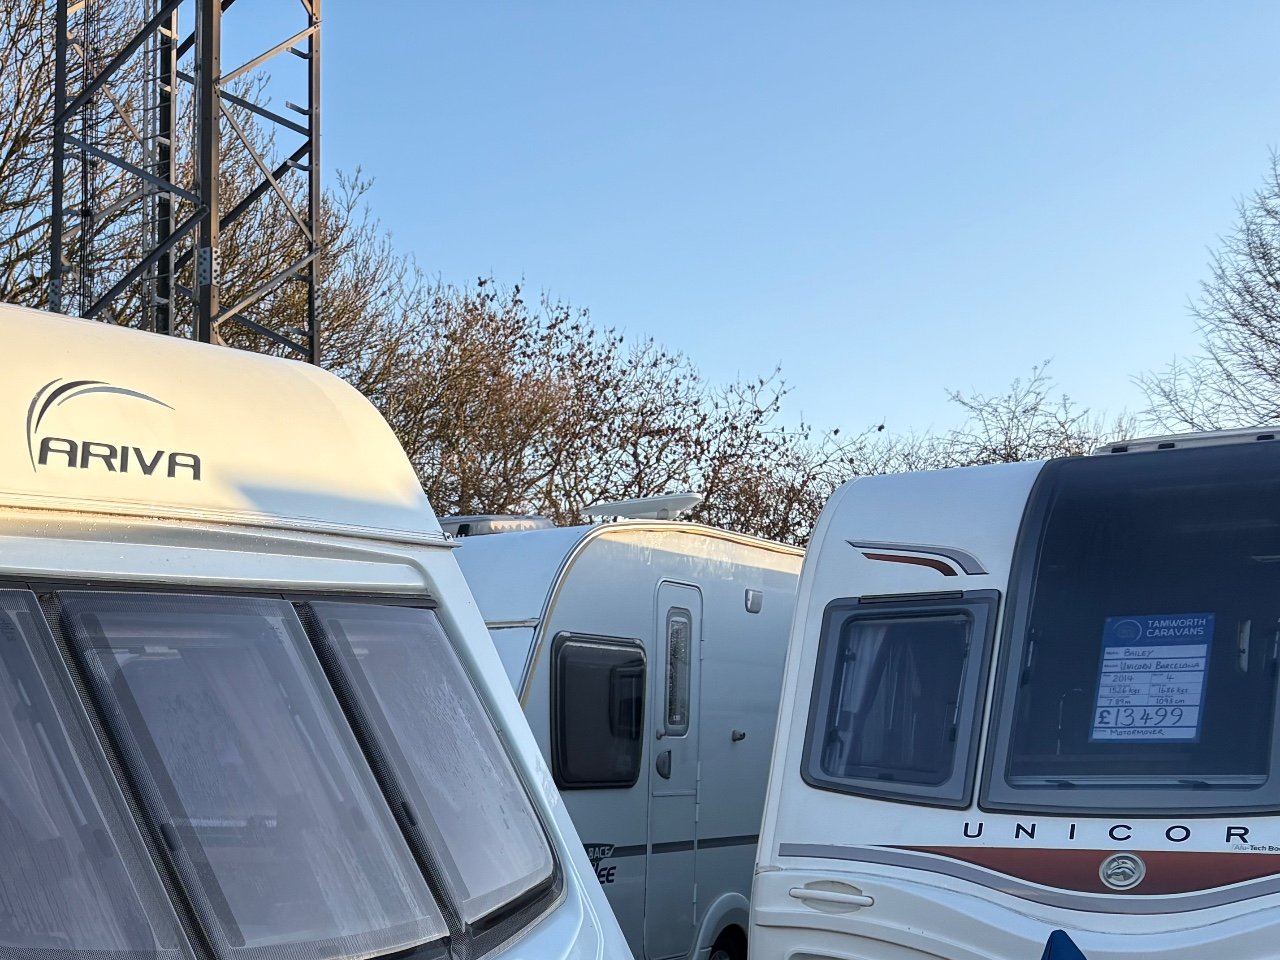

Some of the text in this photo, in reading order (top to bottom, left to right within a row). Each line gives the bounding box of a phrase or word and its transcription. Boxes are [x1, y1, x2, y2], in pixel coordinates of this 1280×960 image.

[38, 436, 201, 481] ARIVA
[1147, 618, 1206, 627] TAMWORTH
[1146, 627, 1204, 637] CARAVANS
[1123, 648, 1154, 658] BAILEY
[963, 822, 1250, 844] UNICOR
